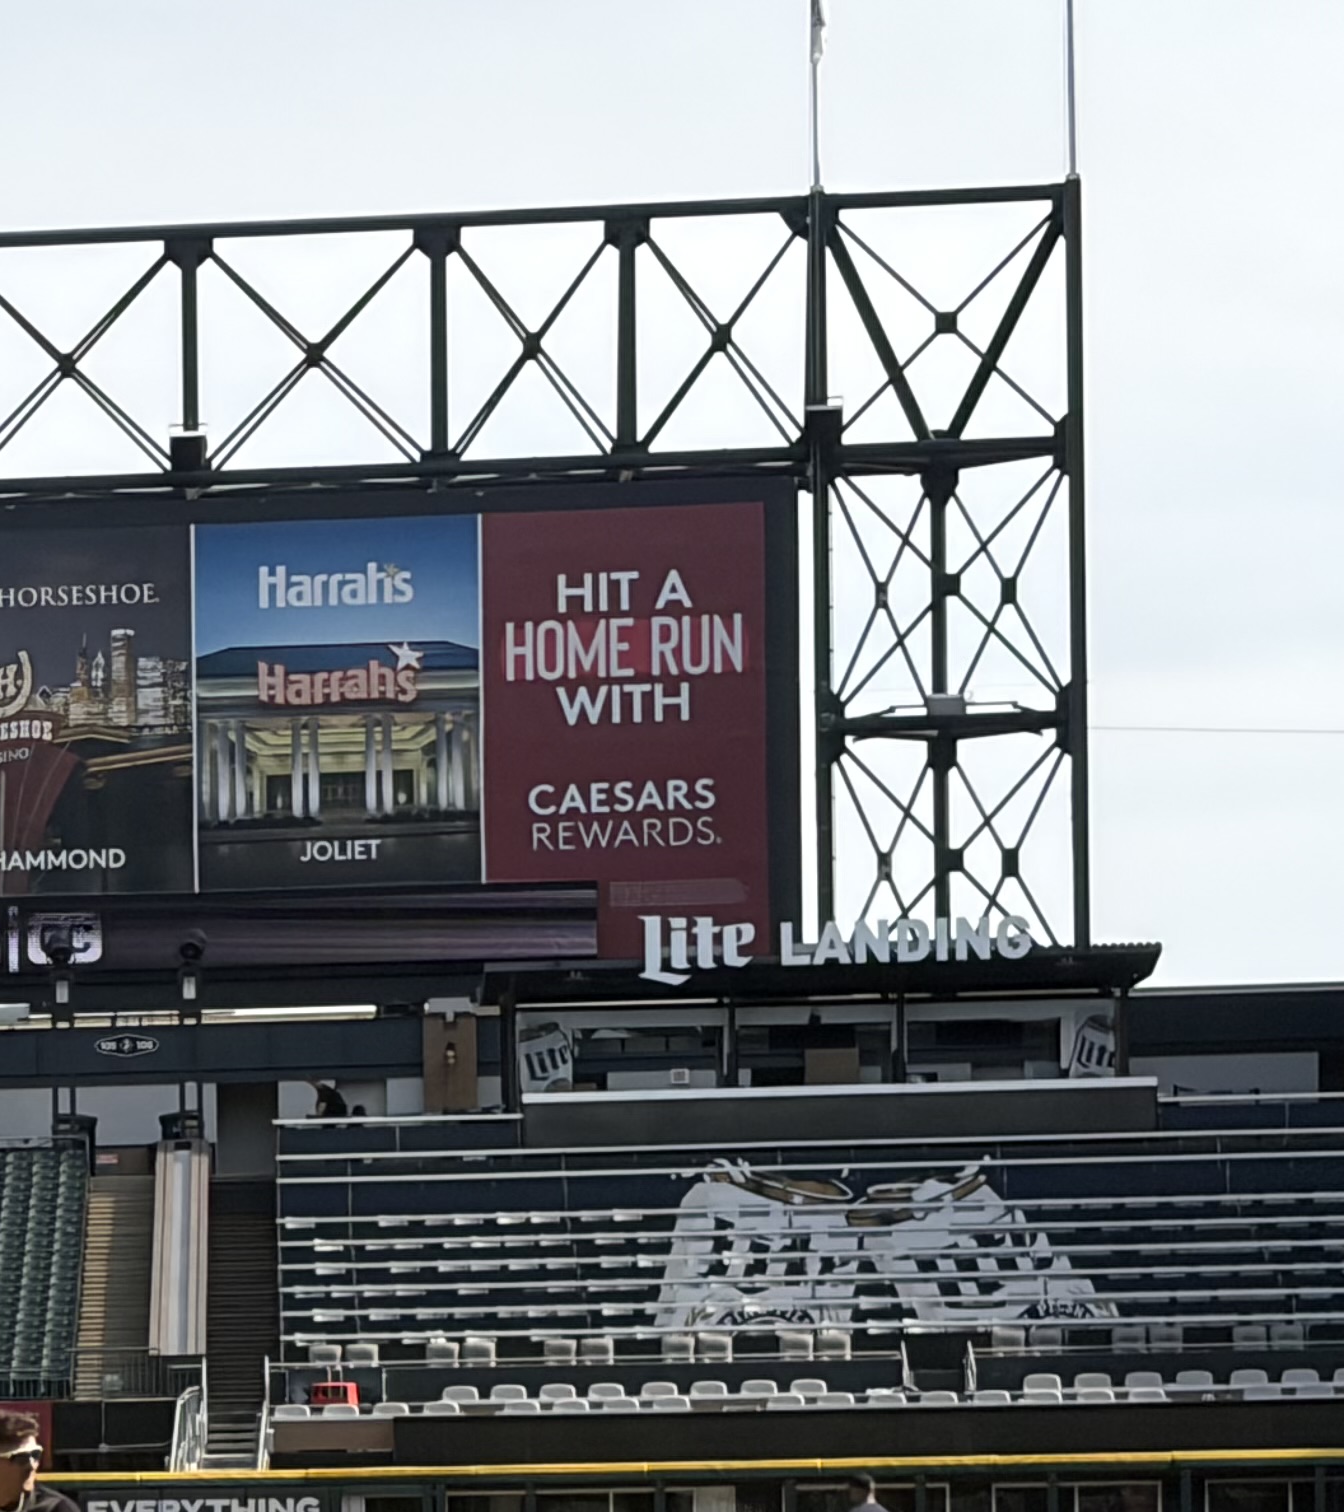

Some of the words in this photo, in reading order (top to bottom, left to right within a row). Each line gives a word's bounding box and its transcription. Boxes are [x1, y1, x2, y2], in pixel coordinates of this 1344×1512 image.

[557, 571, 639, 612] HIT
[655, 569, 693, 609] A
[505, 618, 635, 682] HOME
[650, 613, 744, 676] RUN
[556, 682, 691, 726] WITH
[528, 778, 716, 815] CAESARS
[299, 839, 381, 863] JOLIET
[637, 914, 756, 986] Lite
[779, 914, 1033, 967] LANDING
